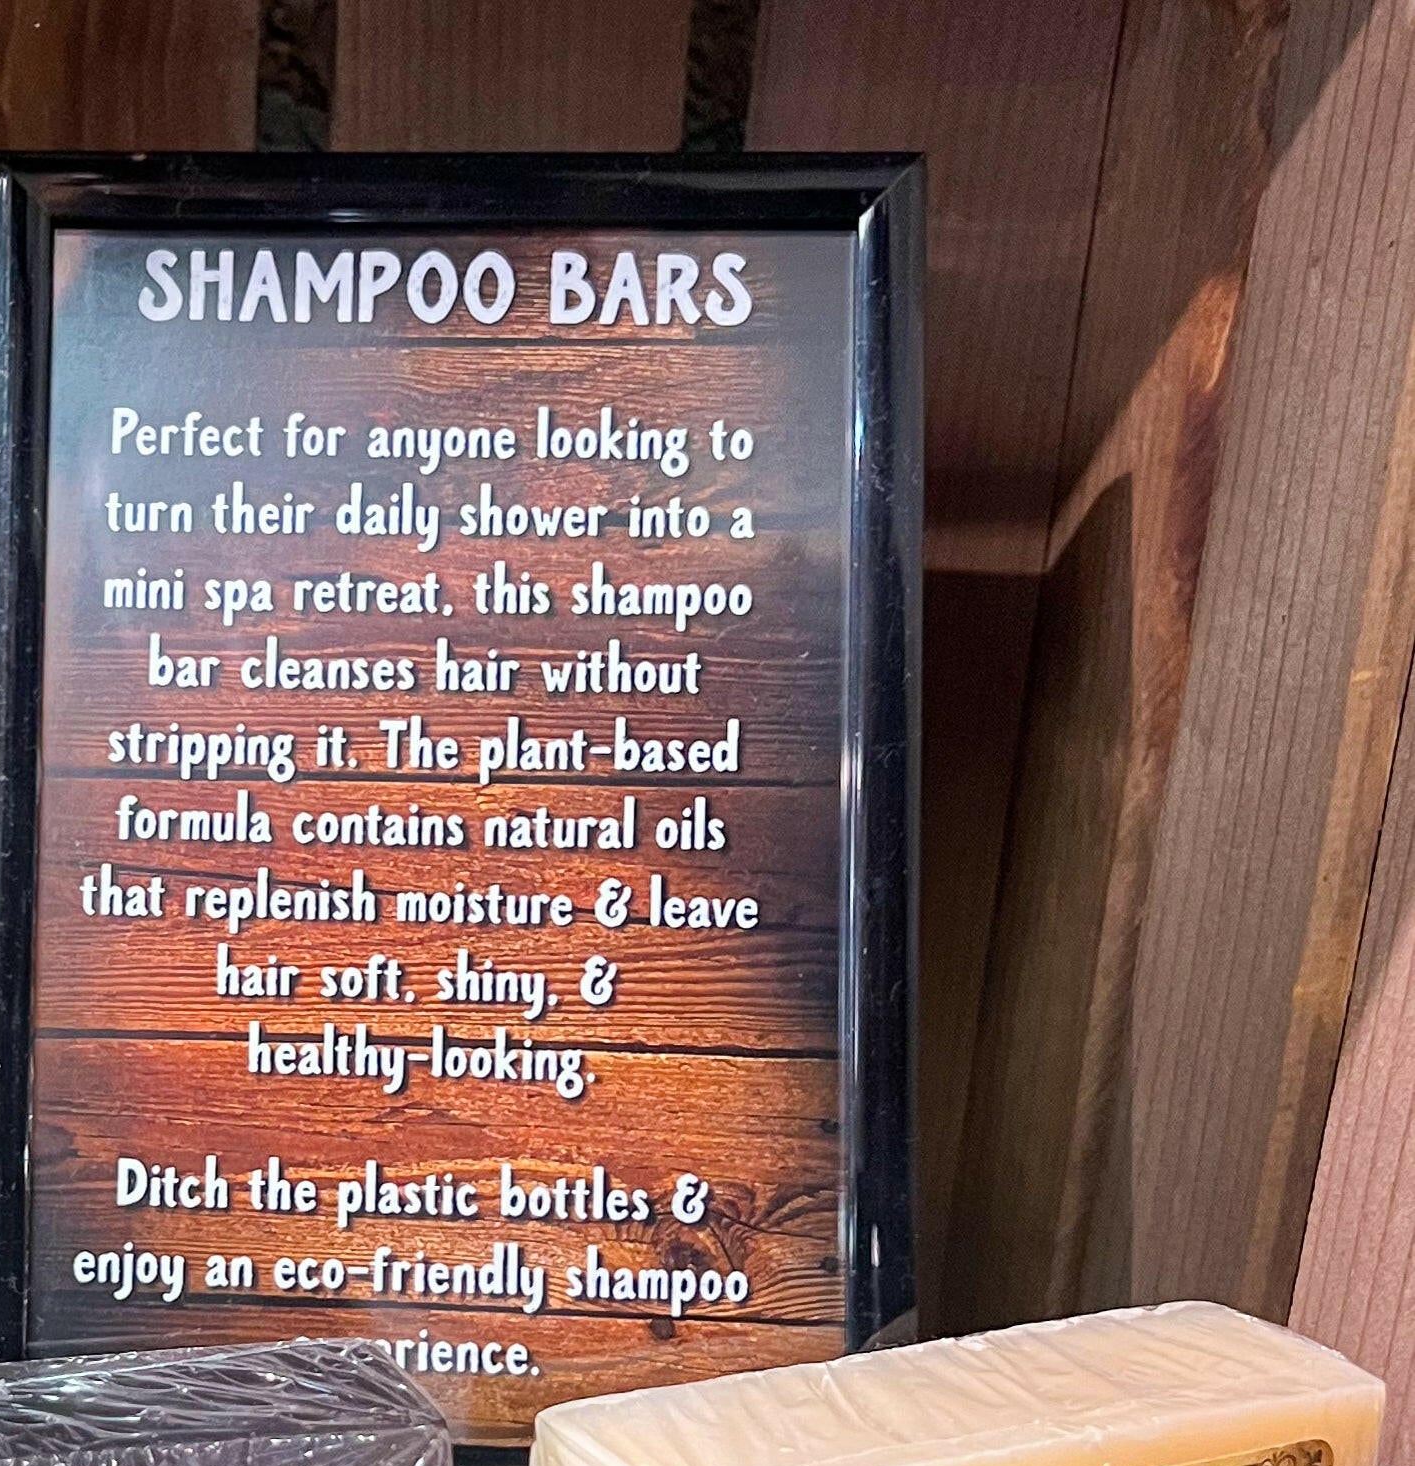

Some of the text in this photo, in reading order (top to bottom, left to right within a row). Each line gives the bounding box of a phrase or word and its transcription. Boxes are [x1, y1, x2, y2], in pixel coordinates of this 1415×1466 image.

[138, 249, 753, 326] SHAMPOO BARS
[111, 405, 754, 478] Perfect for anyone looking to
[103, 480, 755, 554] turn their daily shower into a
[103, 560, 753, 632] mini spa retreat, this shampoo
[148, 631, 702, 694] bar cleanses hair without
[107, 715, 740, 783] stripping it. The plant-based
[114, 790, 726, 851] formula contains natural oils
[78, 862, 758, 935] that replenish moisture & leave
[213, 942, 618, 1020] hair soft, shiny, &
[247, 1022, 597, 1099] healthy-looking.
[116, 1154, 709, 1229] Ditch the plastic bottles &
[73, 1241, 749, 1317] enjoy an eco-friendly shampoo
[375, 1328, 540, 1377] rience.
